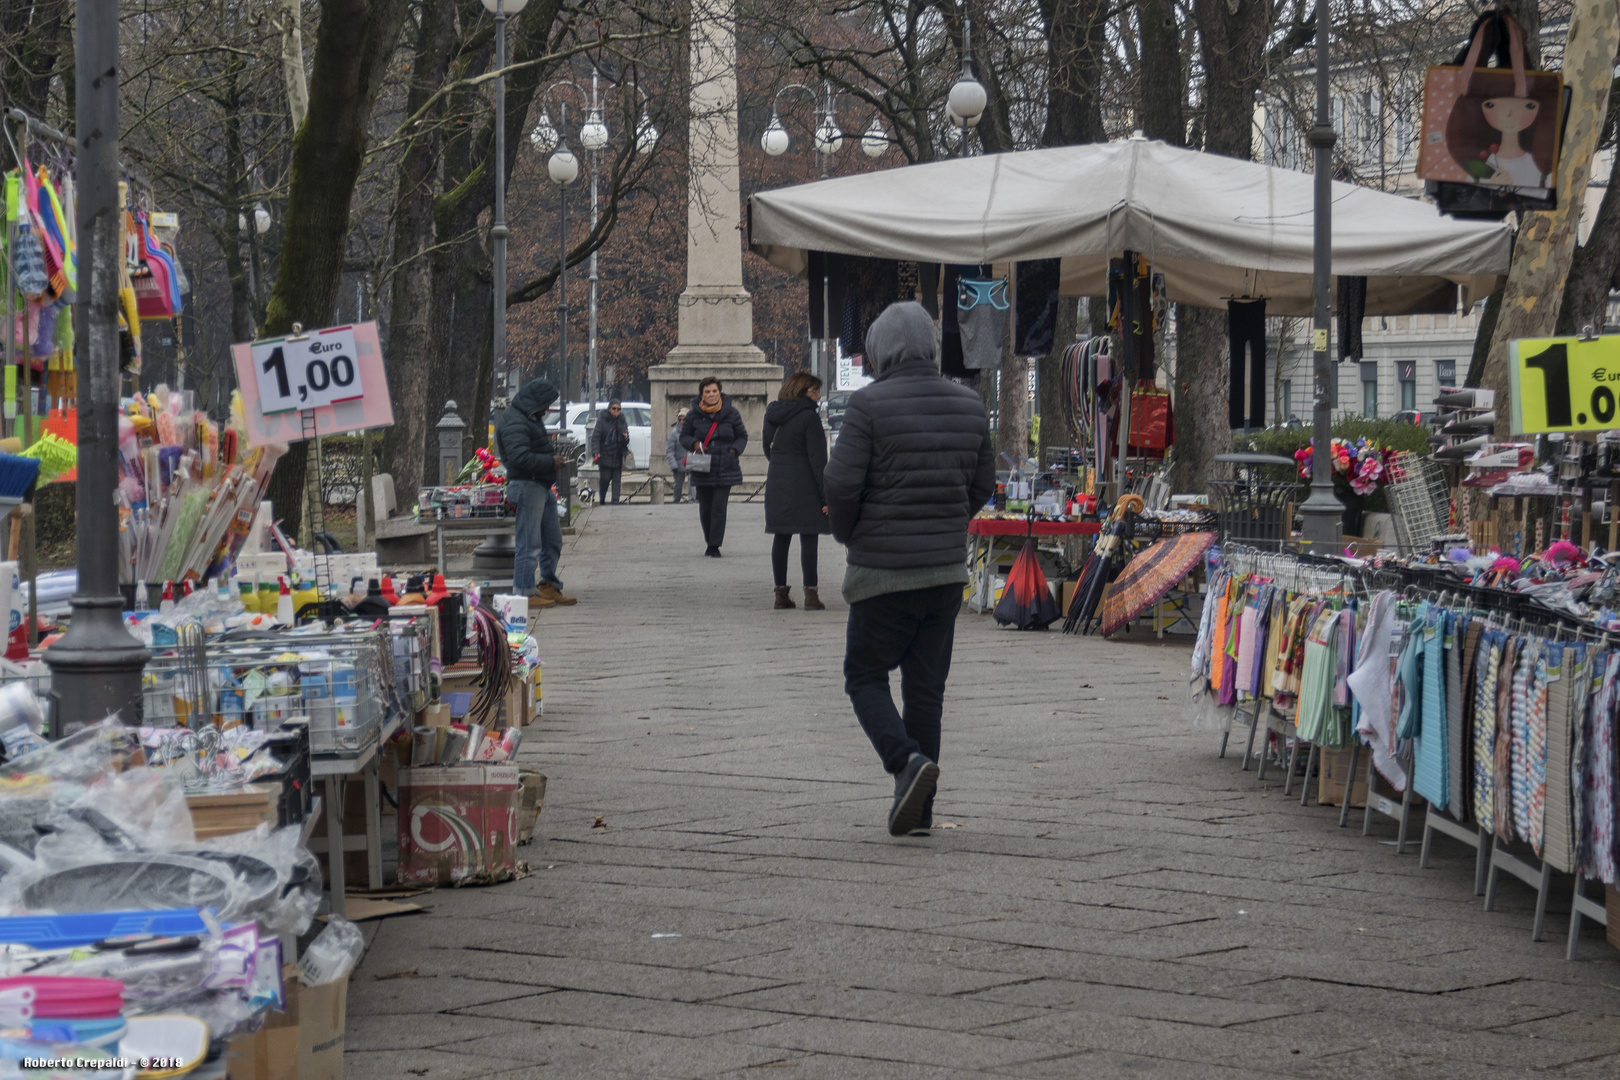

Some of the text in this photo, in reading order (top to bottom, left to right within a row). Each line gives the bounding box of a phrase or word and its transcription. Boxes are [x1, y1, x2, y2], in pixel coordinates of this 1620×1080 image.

[308, 341, 343, 355] €uro
[262, 346, 355, 403] 1,00
[840, 361, 850, 387] STEVE
[1525, 343, 1620, 427] 1.0
